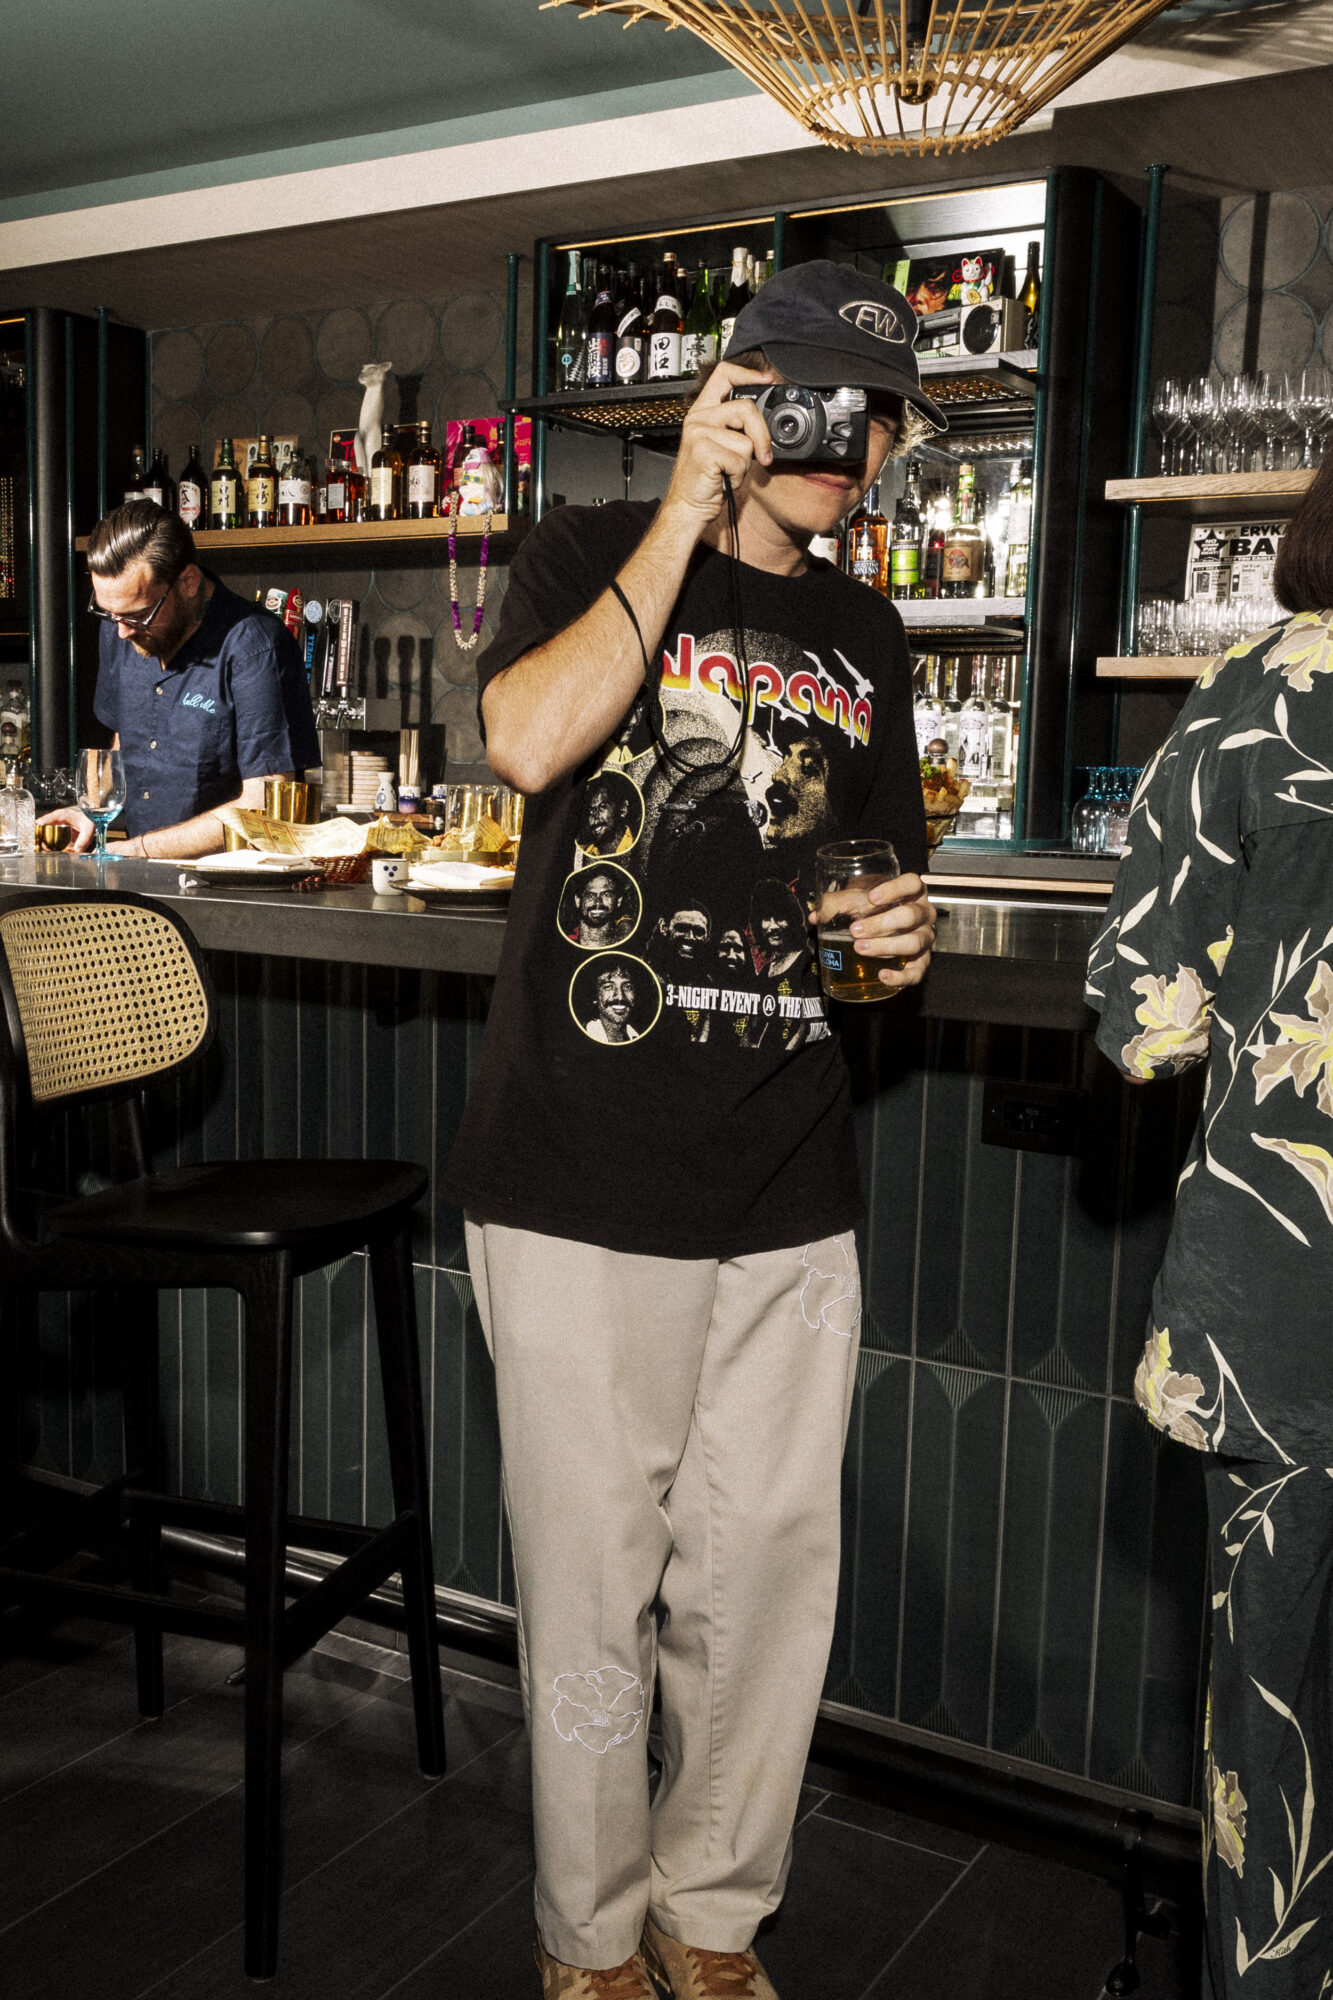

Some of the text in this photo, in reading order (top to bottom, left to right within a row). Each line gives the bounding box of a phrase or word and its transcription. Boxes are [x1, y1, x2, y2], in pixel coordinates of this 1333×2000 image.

[1240, 525, 1285, 537] ERYK
[1229, 538, 1280, 556] BA
[305, 634, 315, 669] SWELL
[666, 984, 719, 1011] 3-NIGHT
[720, 989, 760, 1015] EVENT
[778, 996, 802, 1019] THE
